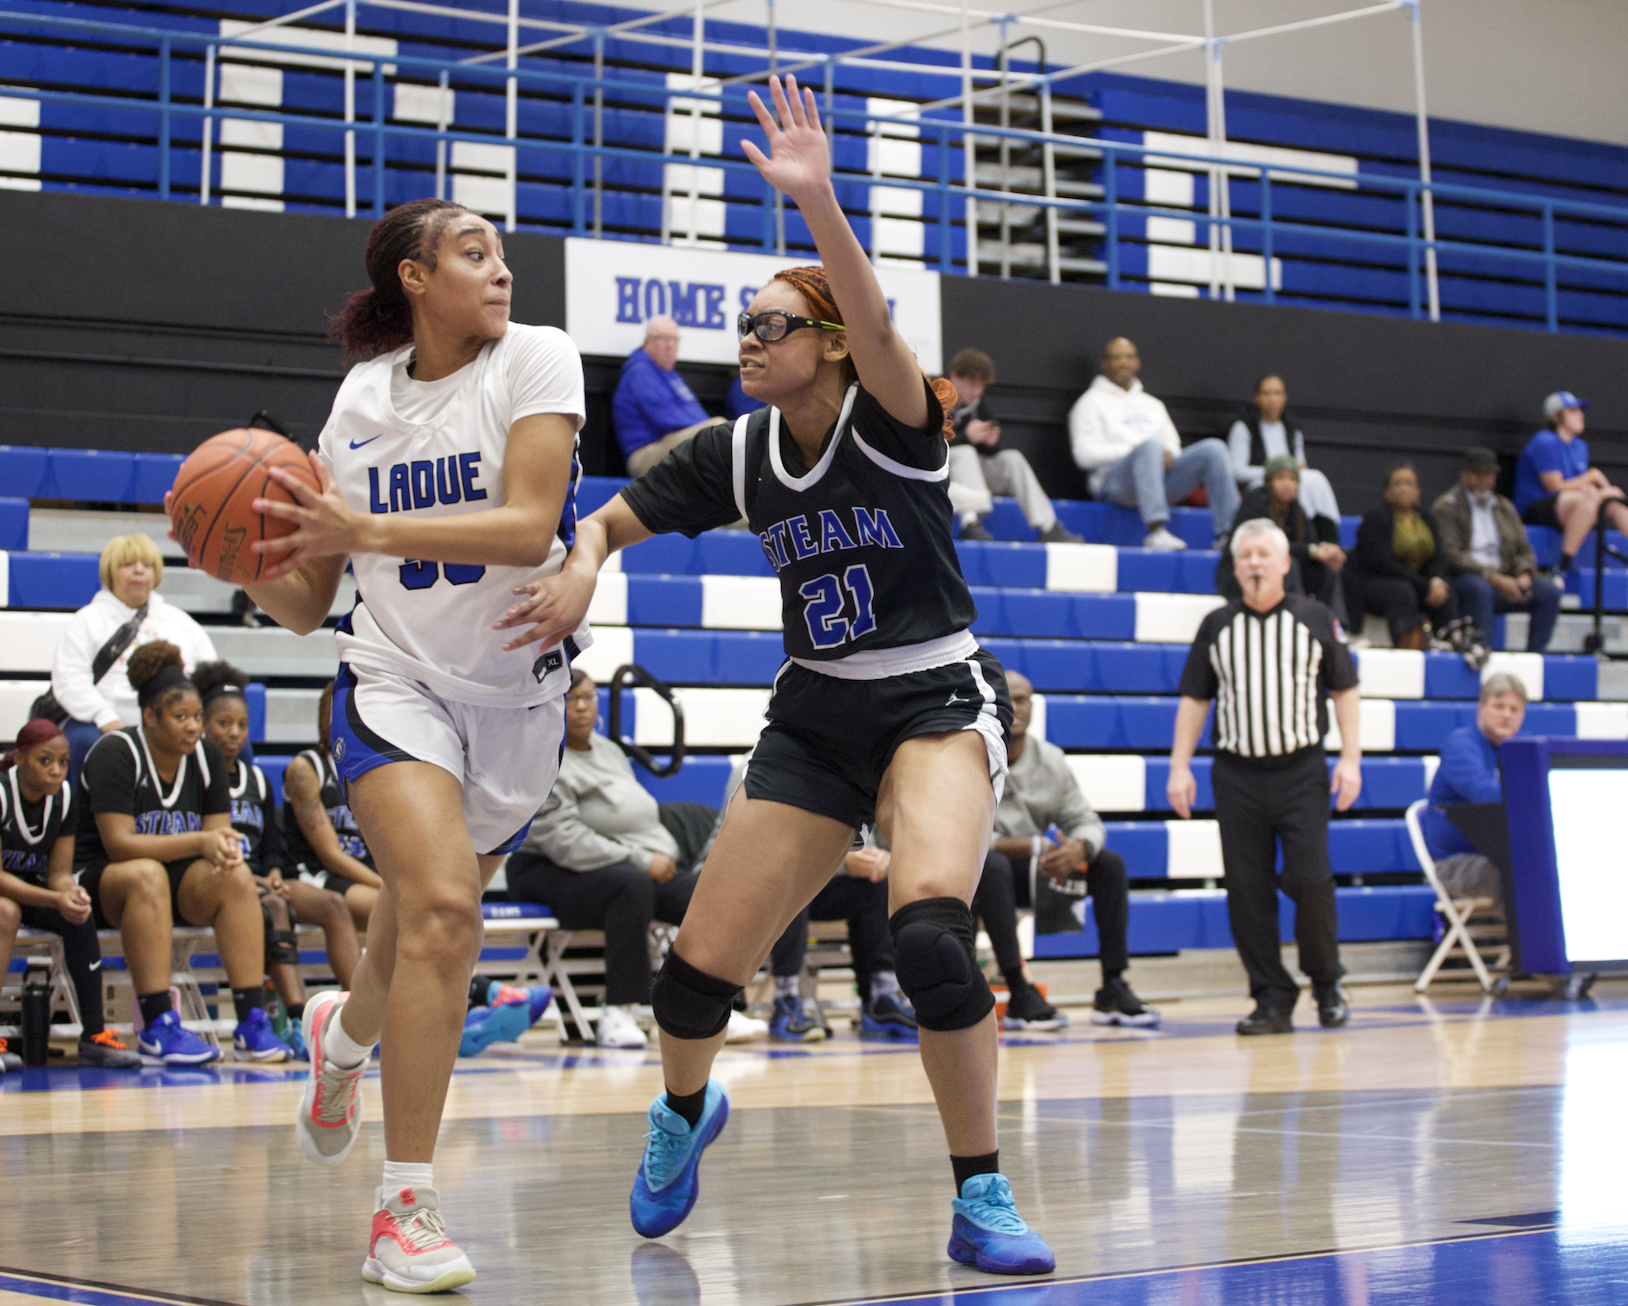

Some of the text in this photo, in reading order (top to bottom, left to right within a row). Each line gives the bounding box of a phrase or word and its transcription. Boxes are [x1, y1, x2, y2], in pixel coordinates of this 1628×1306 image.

[615, 276, 725, 330] HOME
[368, 451, 488, 514] LADUE
[759, 506, 904, 573] STEAM
[798, 563, 877, 650] 21
[546, 657, 560, 667] XL
